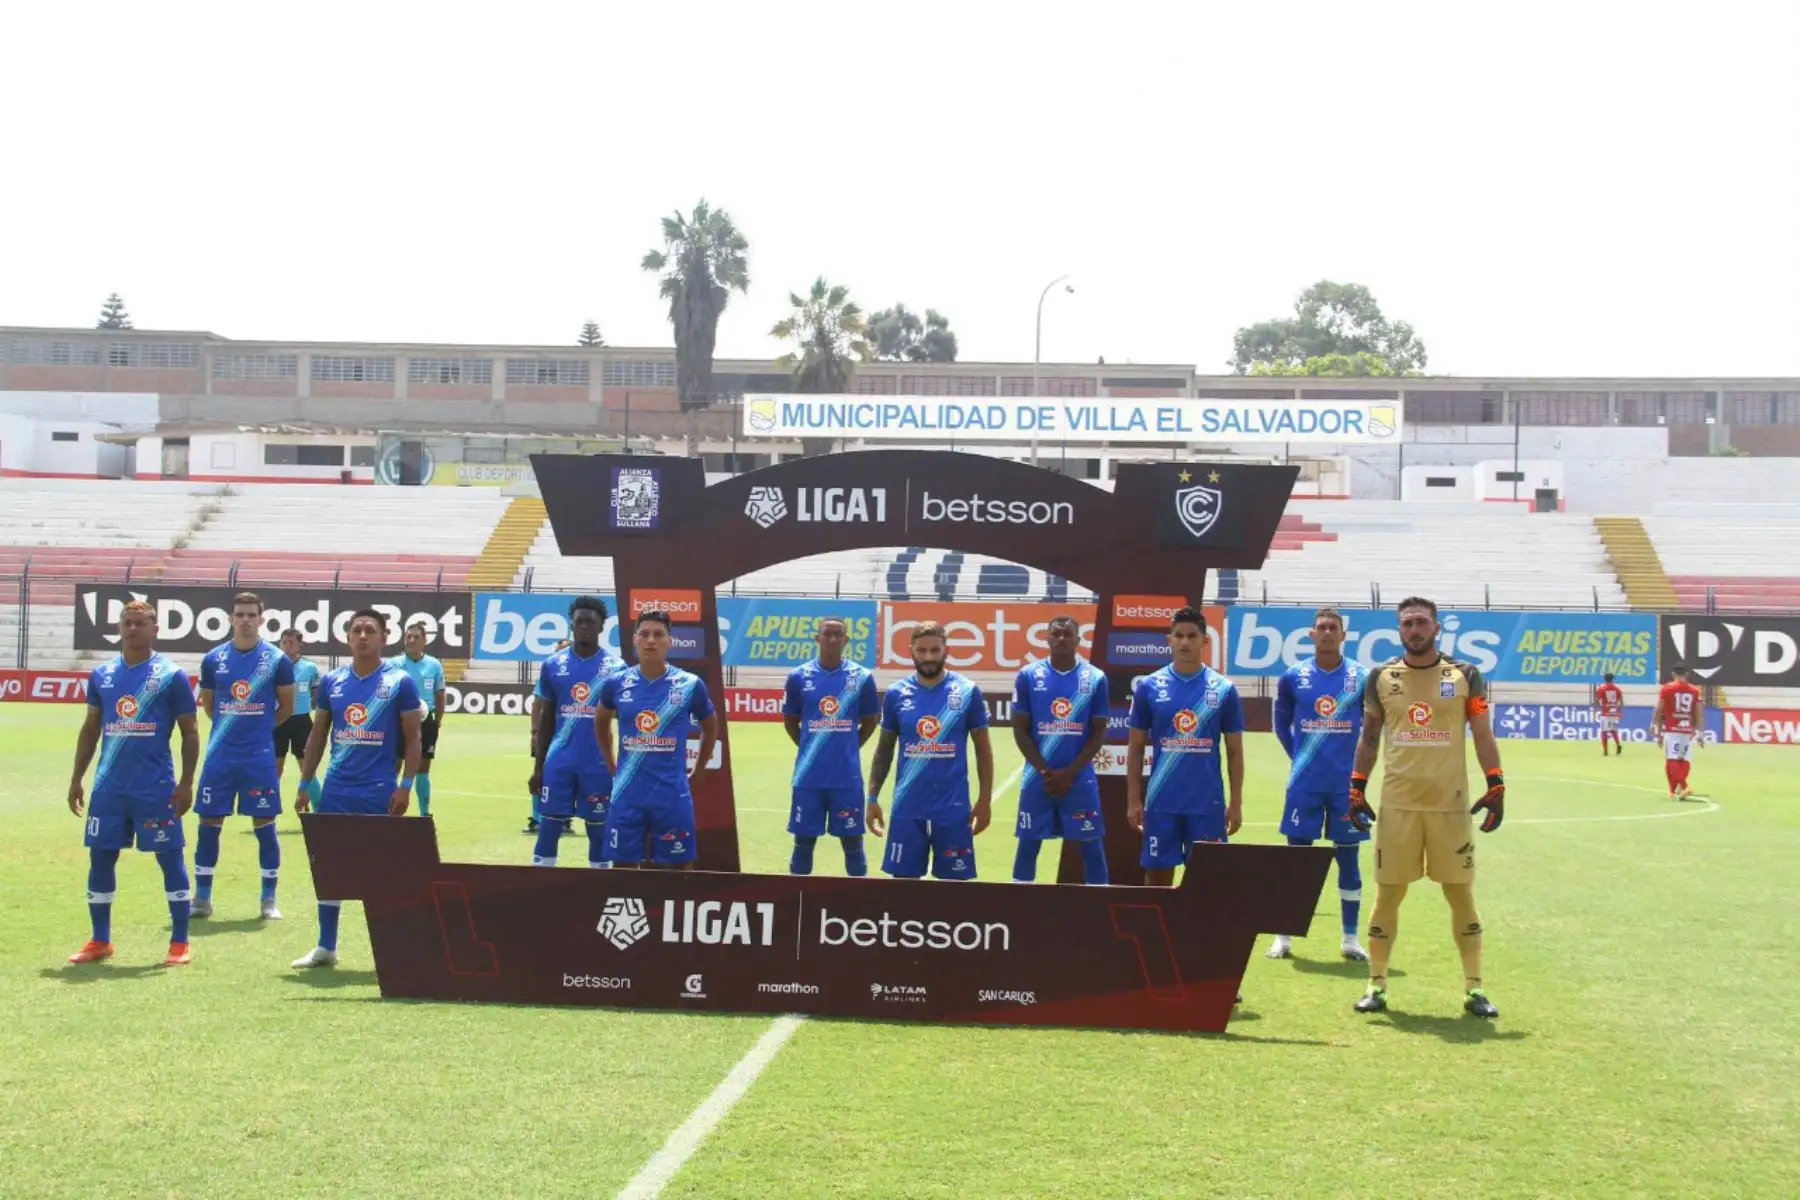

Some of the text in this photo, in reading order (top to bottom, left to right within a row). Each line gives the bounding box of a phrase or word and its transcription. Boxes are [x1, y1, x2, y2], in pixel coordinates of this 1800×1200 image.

[782, 403, 1365, 434] MUNICIPALIDAD DE VILLA EL SALVADOR
[922, 491, 1074, 525] betsson
[633, 598, 699, 613] betsson
[745, 615, 872, 640] APUESAS
[749, 640, 867, 661] DEPORAS
[1116, 644, 1172, 656] marathon
[1517, 630, 1652, 655] APUESTAS
[1754, 630, 1800, 674] D
[1520, 656, 1647, 677] DEPORTIVAS
[1674, 692, 1694, 713] 19
[1548, 721, 1647, 742] Peruno
[202, 787, 212, 804] 5
[87, 816, 100, 836] 10
[1019, 811, 1031, 829] 31
[1291, 808, 1299, 826] 4
[609, 828, 618, 849] 3
[890, 842, 903, 863] 11
[819, 908, 1009, 951] betsson
[563, 974, 631, 989] betsson
[758, 981, 819, 994] marathon
[884, 986, 926, 994] LATAM
